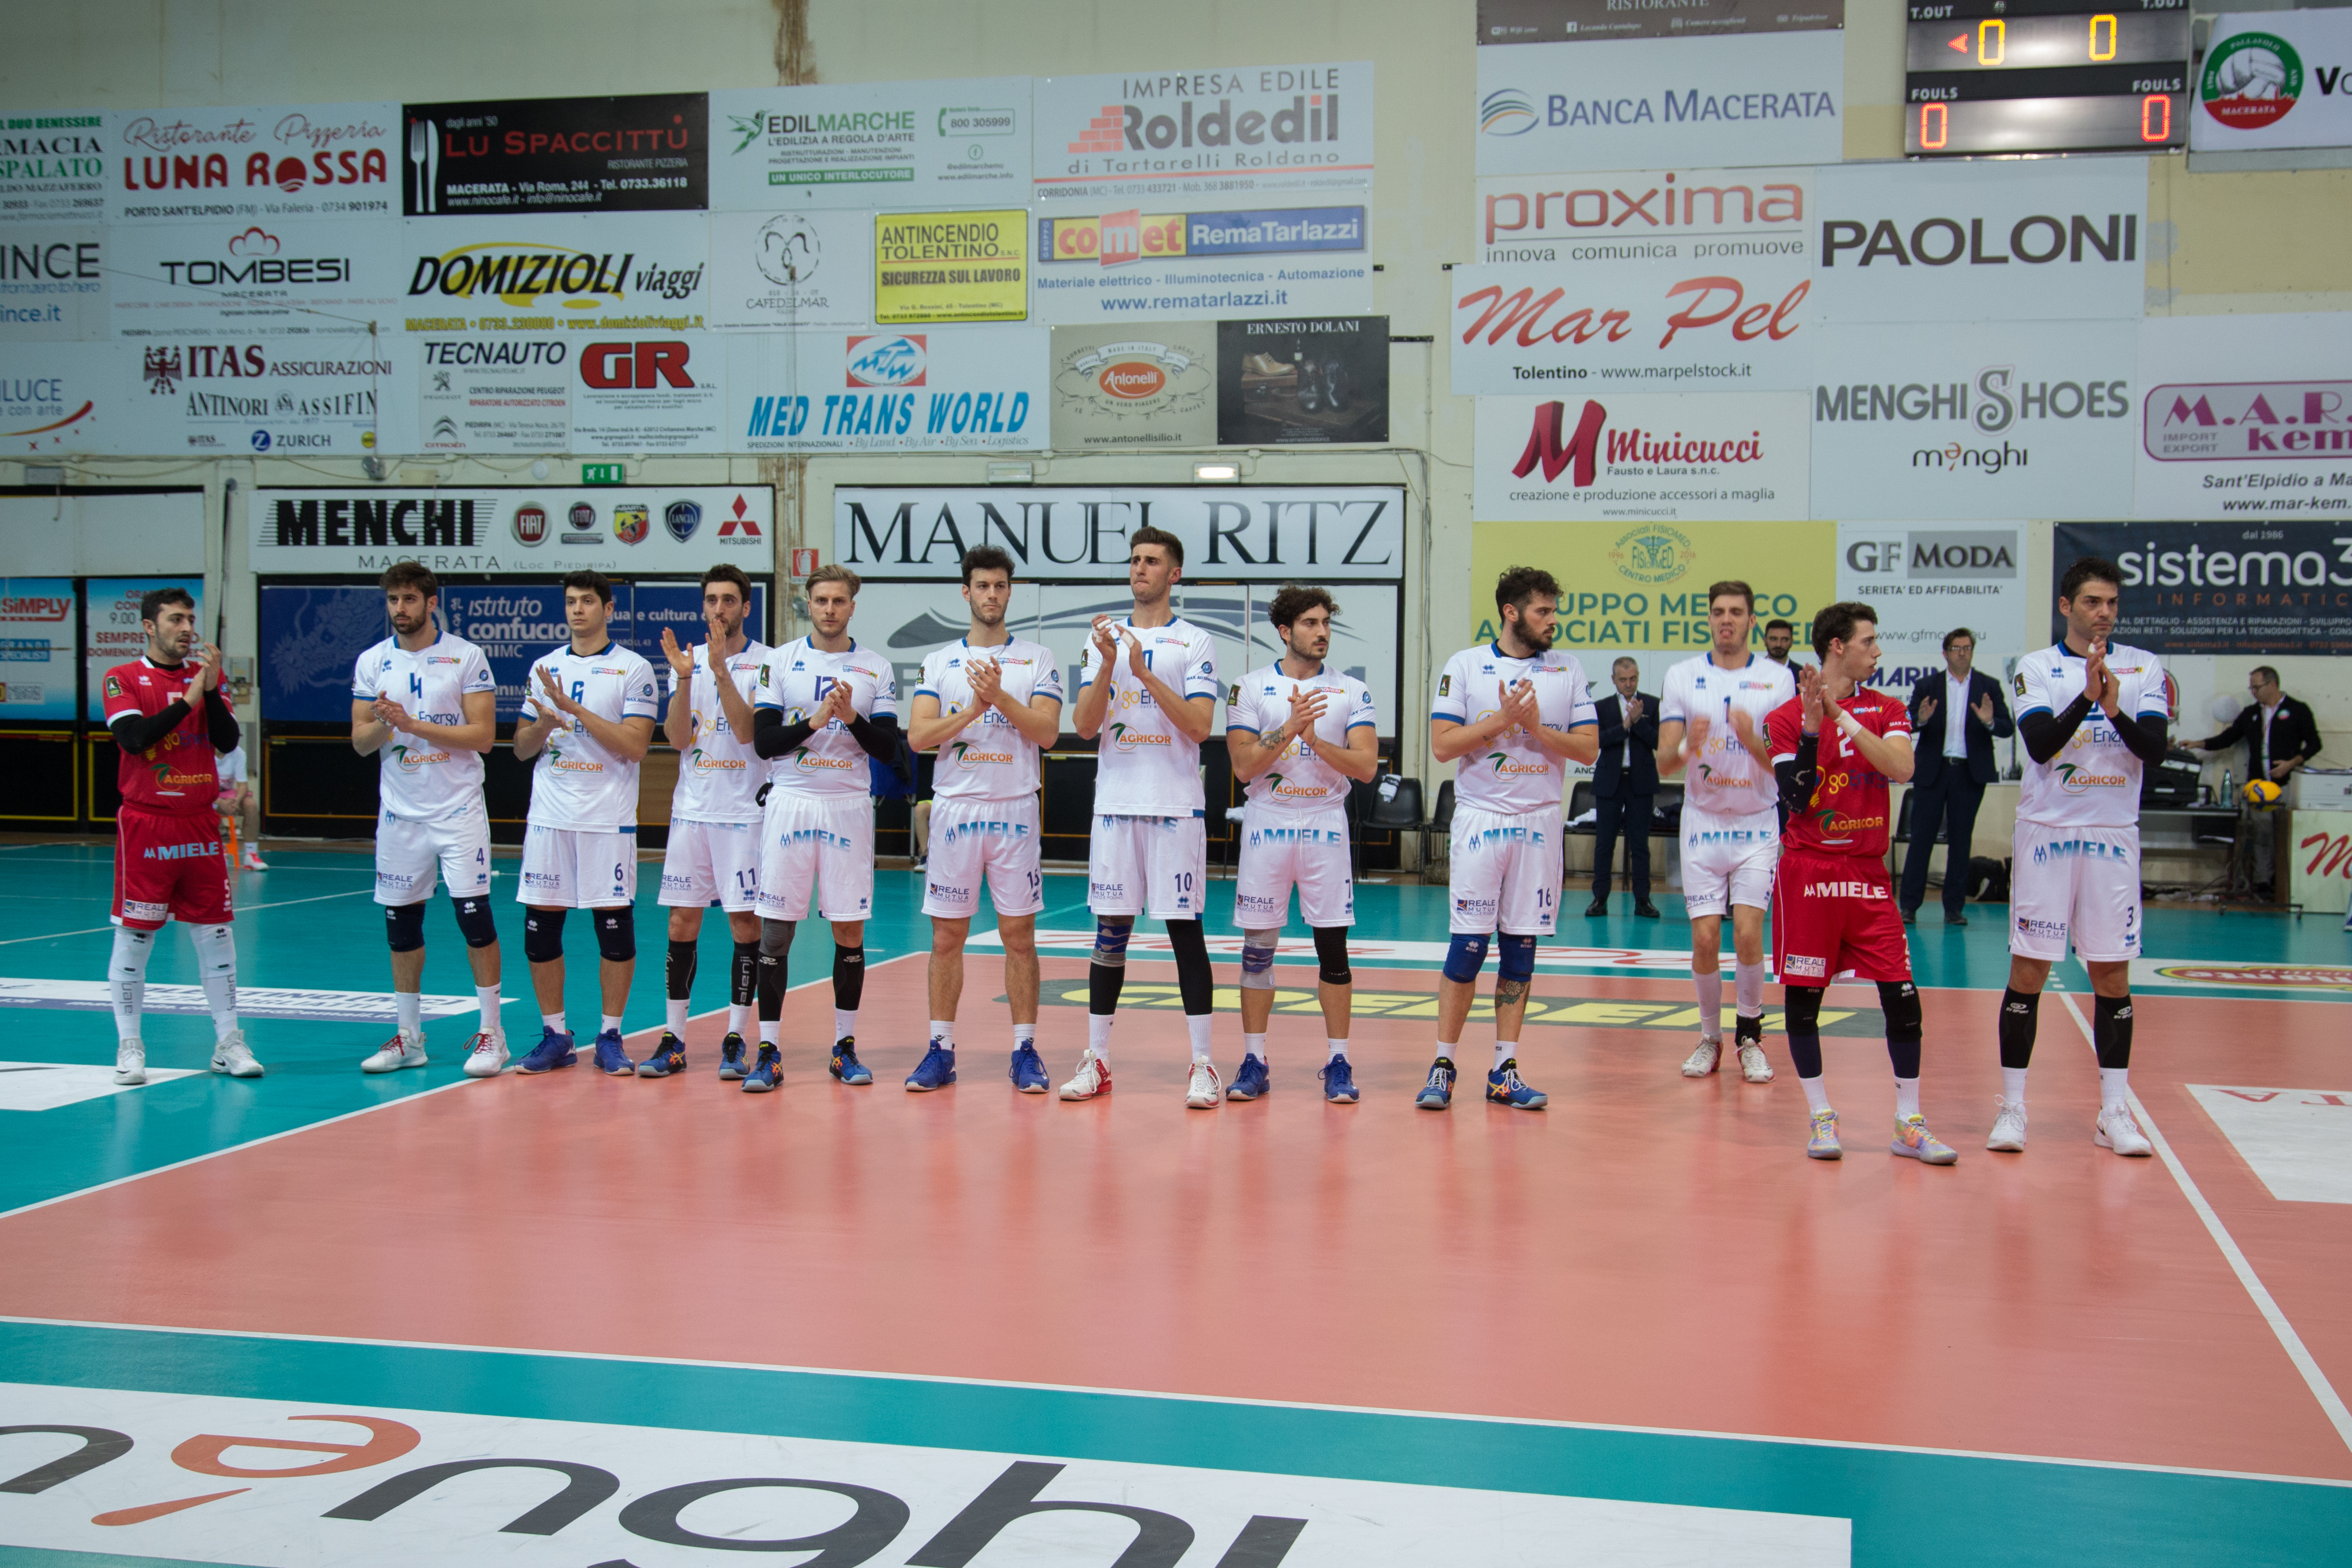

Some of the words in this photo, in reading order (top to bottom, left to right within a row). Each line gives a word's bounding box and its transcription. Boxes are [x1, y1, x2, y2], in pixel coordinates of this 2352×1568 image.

[1911, 5, 1953, 19] T.OUT
[1123, 73, 1244, 99] IMPRESA
[1260, 68, 1339, 92] EDILE
[2133, 78, 2180, 93] FOULS
[1912, 87, 1957, 100] FOULS
[1548, 94, 1653, 127] BANCA
[1664, 89, 1836, 122] MACERATA
[2221, 105, 2276, 116] MACERATA
[769, 111, 914, 133] EDILMARCHE
[951, 118, 970, 128] 800
[973, 117, 1010, 127] 305999
[1123, 93, 1339, 151] Roldedil
[1921, 103, 1947, 149] 0
[2141, 95, 2170, 142] 0
[123, 118, 256, 151] Ristorante
[273, 113, 386, 149] Pizzeria
[769, 137, 818, 146] L'EDILIZIA
[832, 135, 874, 143] REGOLA
[877, 133, 914, 142] D'ARTE
[125, 153, 228, 190] LUNA
[246, 148, 386, 192] ROSSA
[608, 159, 654, 169] RISTORANTE
[656, 158, 687, 168] PIZZERIA
[1068, 159, 1089, 174] di
[1104, 154, 1220, 172] Tartarelli
[1236, 151, 1339, 167] Roldano
[772, 173, 789, 182] UN
[791, 172, 821, 182] UNICO
[824, 170, 911, 180] INTERLOCUTORE
[447, 183, 509, 195] MACERATA
[520, 182, 534, 192] Via
[537, 181, 569, 192] Roma,
[572, 180, 589, 190] 244
[601, 180, 617, 190] Tel.
[620, 178, 687, 189] 0733.36118
[1038, 187, 1088, 198] CORRIDONIA
[125, 206, 160, 217] PORTO
[1486, 172, 1803, 245] proxima
[882, 223, 998, 244] ANTINCENDIO
[1058, 219, 1182, 255] comet
[1192, 218, 1358, 245] RemaTarlazzi
[1822, 214, 2137, 267] PAOLONI
[882, 243, 998, 260] TOLENTINO
[1487, 248, 1556, 263] innova
[1572, 244, 1677, 260] comunica
[1695, 241, 1803, 258] promuove
[160, 259, 350, 285] TOMBESI
[407, 253, 634, 295] DOMIZIOLI
[635, 262, 704, 299] viaggi
[882, 270, 945, 286] SICUREZZA
[949, 269, 971, 283] SUL
[974, 268, 1020, 282] LAVORO
[1037, 276, 1094, 289] Materiale
[1098, 275, 1152, 286] elettrico
[1165, 271, 1264, 285] Illuminotecnica
[1277, 268, 1364, 281] Automazione
[747, 297, 828, 309] CAFEDELMAR
[1101, 290, 1287, 310] www.rematarlazzi.it
[1458, 285, 1632, 347] Mar
[1659, 276, 1811, 349] Pel
[406, 317, 466, 330] MACERATA
[567, 315, 704, 330] www.domizioliviaggi.it
[1248, 322, 1306, 334] ERNESTO
[1310, 320, 1359, 333] DOLANI
[188, 345, 265, 377] ITAS
[269, 361, 392, 377] ASSICURAZIONI
[425, 341, 566, 364] TECNAUTO
[580, 341, 696, 389] GR
[1514, 366, 1587, 380] Tolentino
[1601, 363, 1752, 380] www.marpelstock.it
[1105, 371, 1157, 386] Antonelli
[187, 391, 269, 416] ANTINORI
[747, 393, 809, 436] MED
[823, 393, 916, 434] TRANS
[927, 392, 1030, 433] WORLD
[276, 434, 331, 447] ZURICH
[870, 437, 895, 446] Land
[960, 436, 977, 445] Sea
[988, 435, 1028, 447] Logistics
[1084, 433, 1181, 443] www.antonellisilio.it
[1607, 429, 1763, 463] Minicucci
[2164, 433, 2219, 442] IMPORT
[2163, 444, 2219, 453] EXPORT
[1607, 466, 1641, 475] Fausto
[1657, 466, 1687, 475] Laura
[2203, 474, 2308, 491] Sant'Elpidio
[1509, 490, 1570, 502] creazione
[1584, 489, 1656, 504] produzione
[1659, 489, 1718, 500] accessori
[1730, 489, 1774, 503] maglia
[1603, 507, 1676, 517] www.minicucci.it
[277, 499, 470, 546] MENCHI
[520, 515, 543, 534] FIAT
[1202, 501, 1392, 565] RITZ
[2242, 530, 2257, 539] dal
[2260, 531, 2283, 539] 1986
[359, 554, 500, 571] MACERATA
[1847, 541, 1901, 571] GF
[1912, 543, 2015, 569] MODA
[1858, 585, 1906, 594] SERIETA'
[1926, 585, 2003, 594] AFFIDABILITA'
[1555, 593, 1647, 616] UPPO
[1660, 591, 1798, 615] MECO
[648, 609, 697, 621] cultura
[2134, 617, 2180, 625] DETTAGLIO
[2187, 617, 2239, 625] ASSISTENZA
[2247, 617, 2302, 626] RIPARAZIONI
[468, 617, 571, 640] confucio
[2170, 627, 2214, 635] SOLUZIONI
[2249, 627, 2321, 635] TECNODIDATTICA
[96, 632, 145, 644] SEMPRE
[89, 647, 143, 658] DOMENICA
[403, 753, 450, 764] AGRICOR
[554, 761, 603, 771] AGRICOR
[697, 760, 746, 769] AGRICOR
[801, 757, 853, 770] AGRICOR
[963, 753, 1013, 763] AGRICOR
[958, 821, 1028, 840] MIELE
[1264, 828, 1341, 848] MIELE
[1483, 827, 1545, 848] MIELE
[793, 829, 851, 852] MIELE
[157, 841, 219, 860] MIELE
[476, 848, 485, 865] 4
[614, 862, 623, 881] 6
[736, 868, 756, 888] 11
[1175, 872, 1192, 892] 10
[1537, 887, 1552, 908] 16
